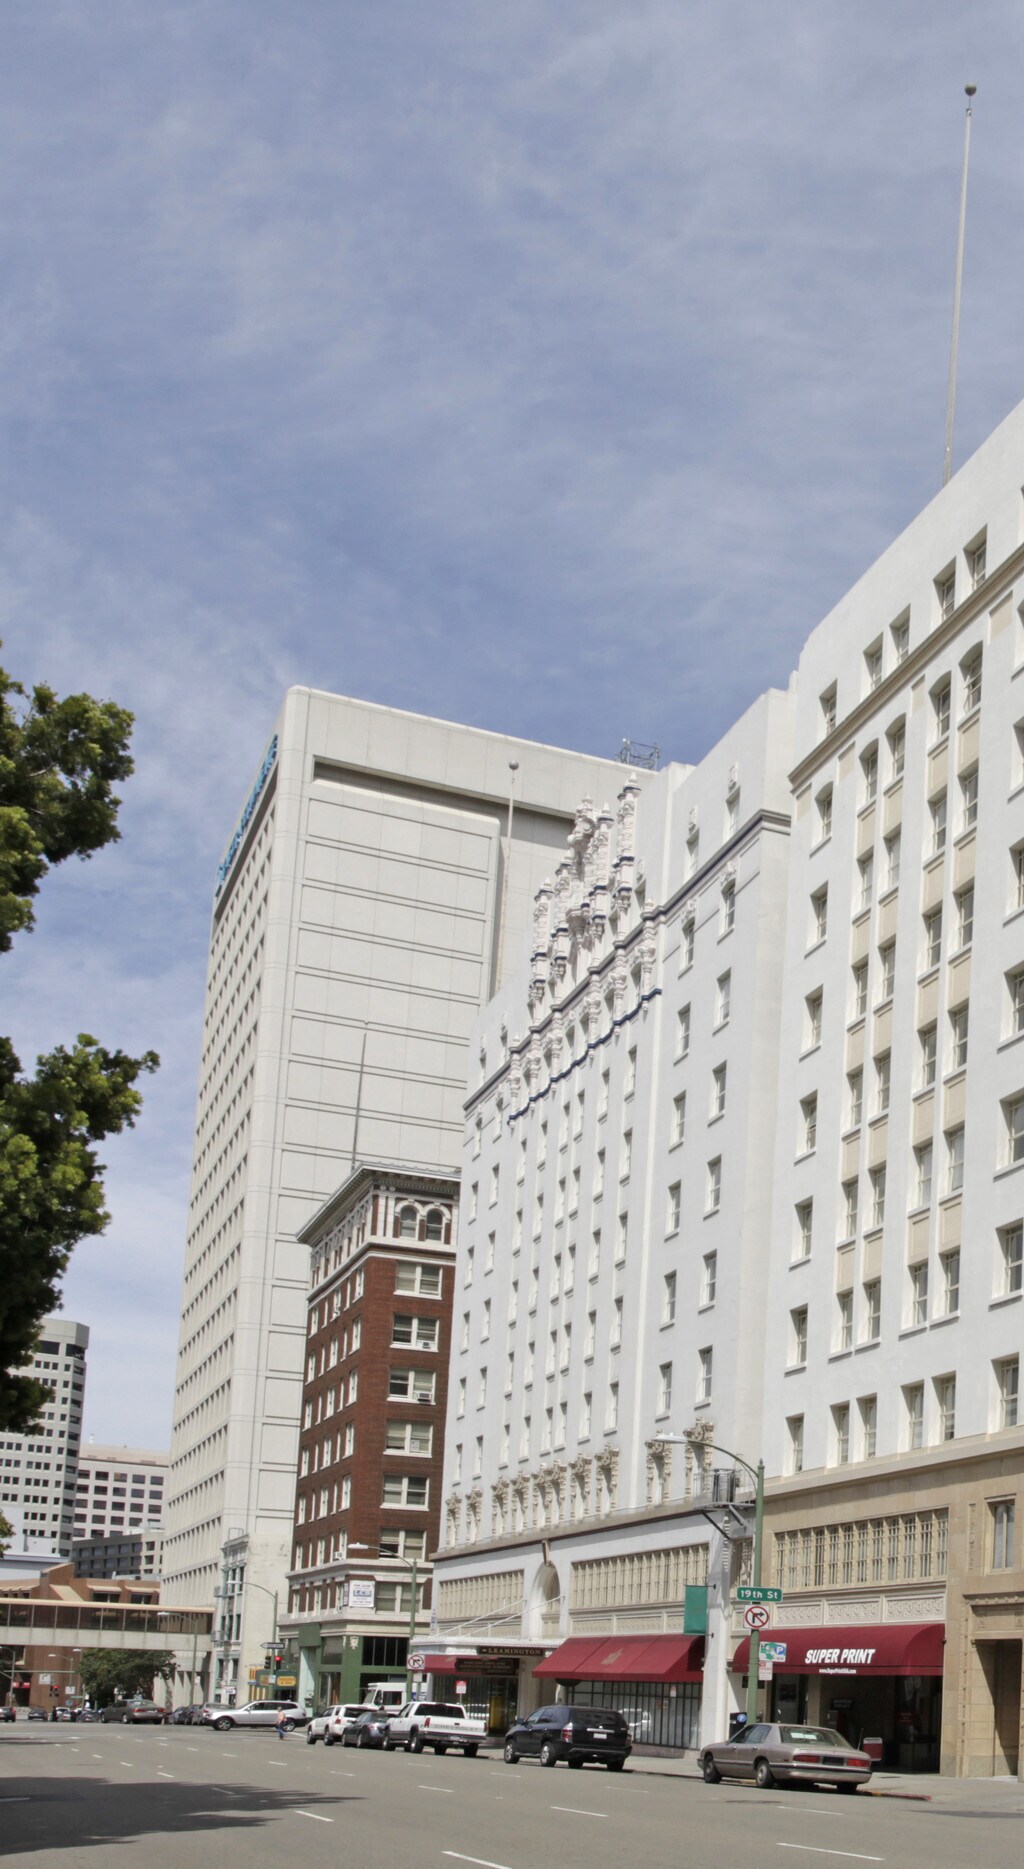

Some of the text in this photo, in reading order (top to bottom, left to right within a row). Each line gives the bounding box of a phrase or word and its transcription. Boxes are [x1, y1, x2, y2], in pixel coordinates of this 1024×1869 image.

[740, 1589, 778, 1599] 19th St
[805, 1648, 876, 1664] SUPER PRINT
